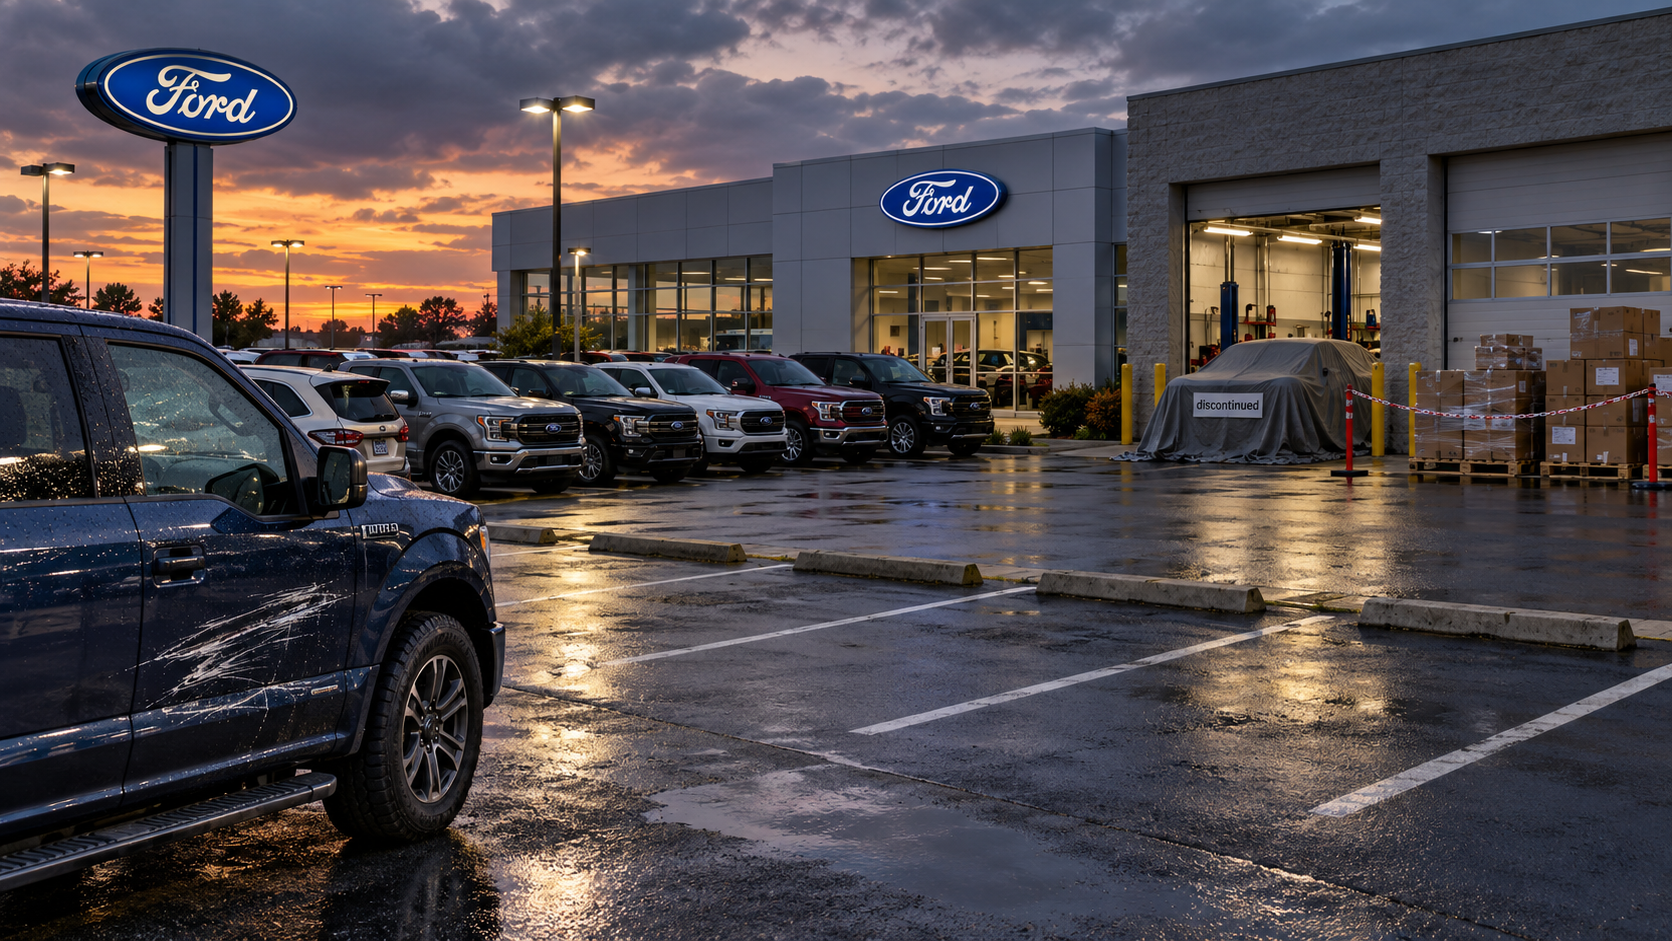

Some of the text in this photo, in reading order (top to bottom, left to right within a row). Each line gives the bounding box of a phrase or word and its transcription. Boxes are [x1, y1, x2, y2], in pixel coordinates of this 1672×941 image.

[146, 65, 258, 124] Ford
[902, 179, 974, 217] Ford
[1196, 399, 1259, 411] discontinued
